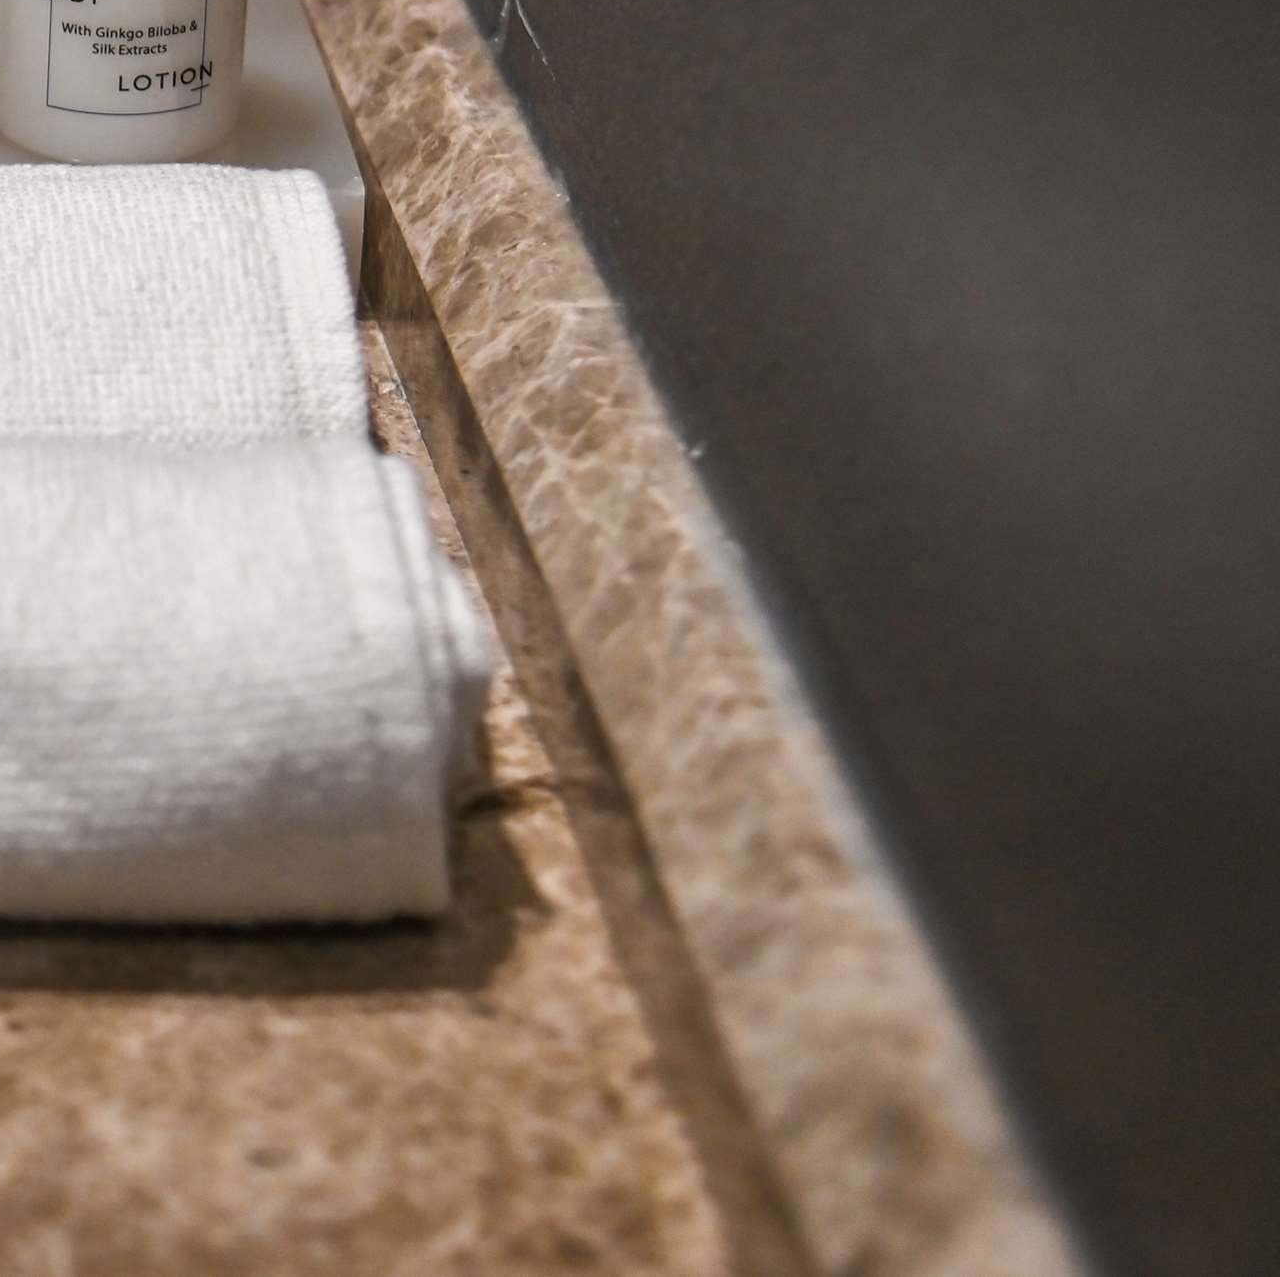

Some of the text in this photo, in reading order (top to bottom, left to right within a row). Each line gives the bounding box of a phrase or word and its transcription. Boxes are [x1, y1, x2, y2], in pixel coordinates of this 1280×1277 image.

[61, 19, 199, 42] With Ginkgo Biloba &
[92, 42, 168, 56] Silk Extracts
[118, 61, 214, 92] LOTION
